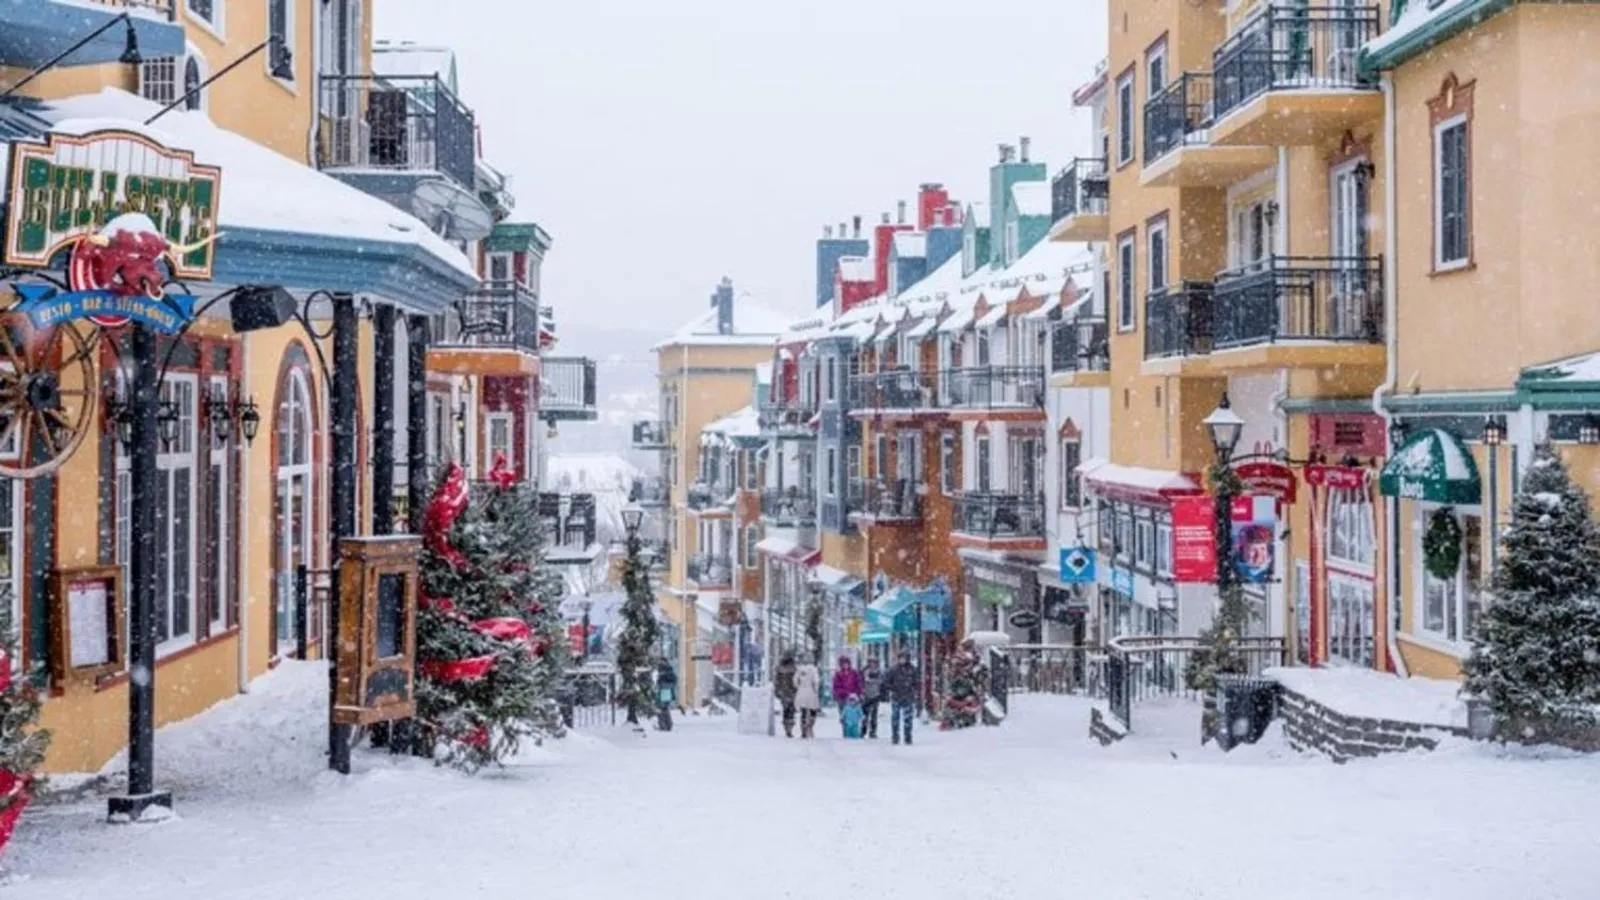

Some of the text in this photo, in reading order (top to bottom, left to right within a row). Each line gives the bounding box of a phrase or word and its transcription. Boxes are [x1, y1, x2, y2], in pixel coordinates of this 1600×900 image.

[18, 157, 212, 266] BULLSEYE
[40, 301, 72, 323] RESTO
[82, 296, 102, 311] BAR
